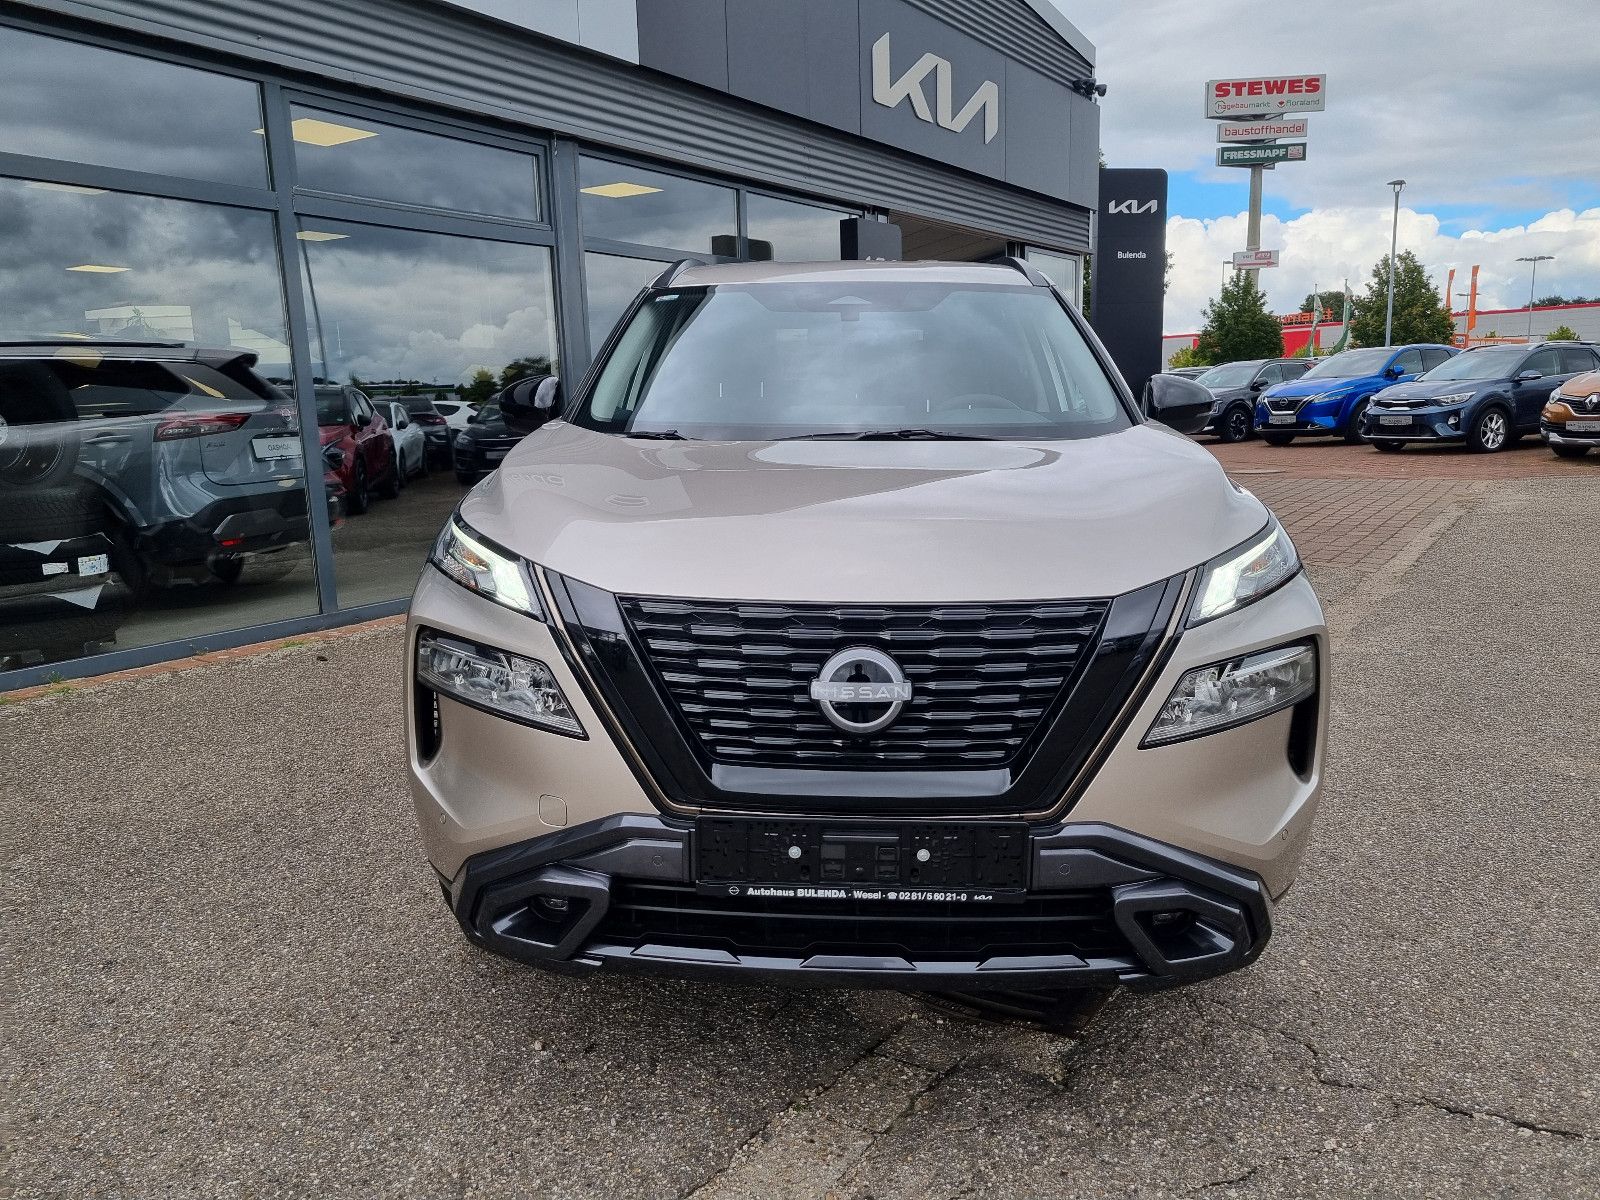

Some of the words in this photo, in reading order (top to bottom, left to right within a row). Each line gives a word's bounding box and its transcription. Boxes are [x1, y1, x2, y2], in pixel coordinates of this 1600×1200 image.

[1214, 77, 1321, 99] STEWES
[1217, 101, 1271, 111] hagebaumarkt
[1224, 123, 1305, 137] baustoffhandel
[1223, 148, 1287, 160] FRESSNAPF
[1117, 250, 1147, 259] Bulenda
[814, 686, 909, 699] NISSAN
[746, 887, 795, 897] Autohaus
[797, 888, 847, 898] BULENDA
[853, 890, 882, 899] Wesel
